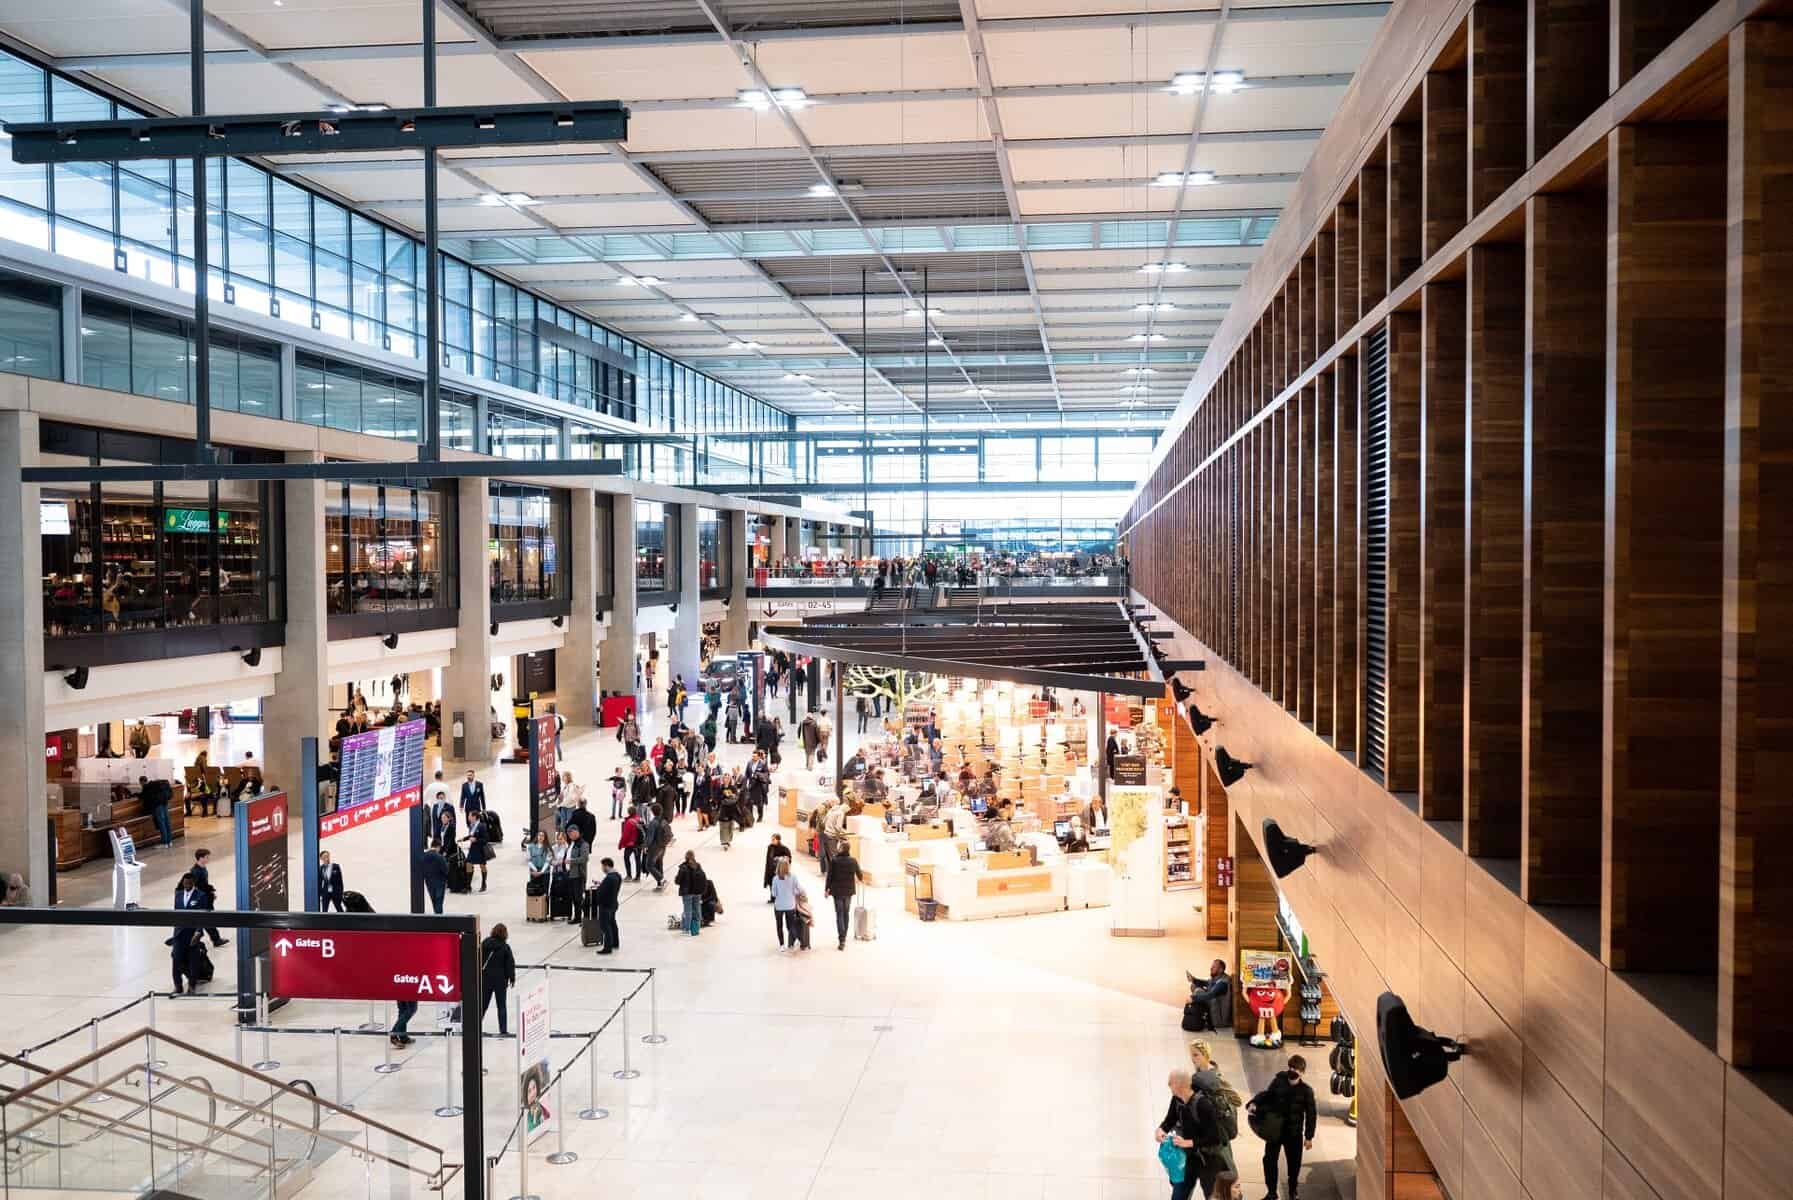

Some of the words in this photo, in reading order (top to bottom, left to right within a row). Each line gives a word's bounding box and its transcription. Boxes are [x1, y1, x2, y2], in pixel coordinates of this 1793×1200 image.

[807, 601, 832, 609] 02-45
[295, 938, 321, 948] Gates
[321, 939, 336, 958] B
[393, 974, 418, 984] Gates
[417, 975, 433, 994] A
